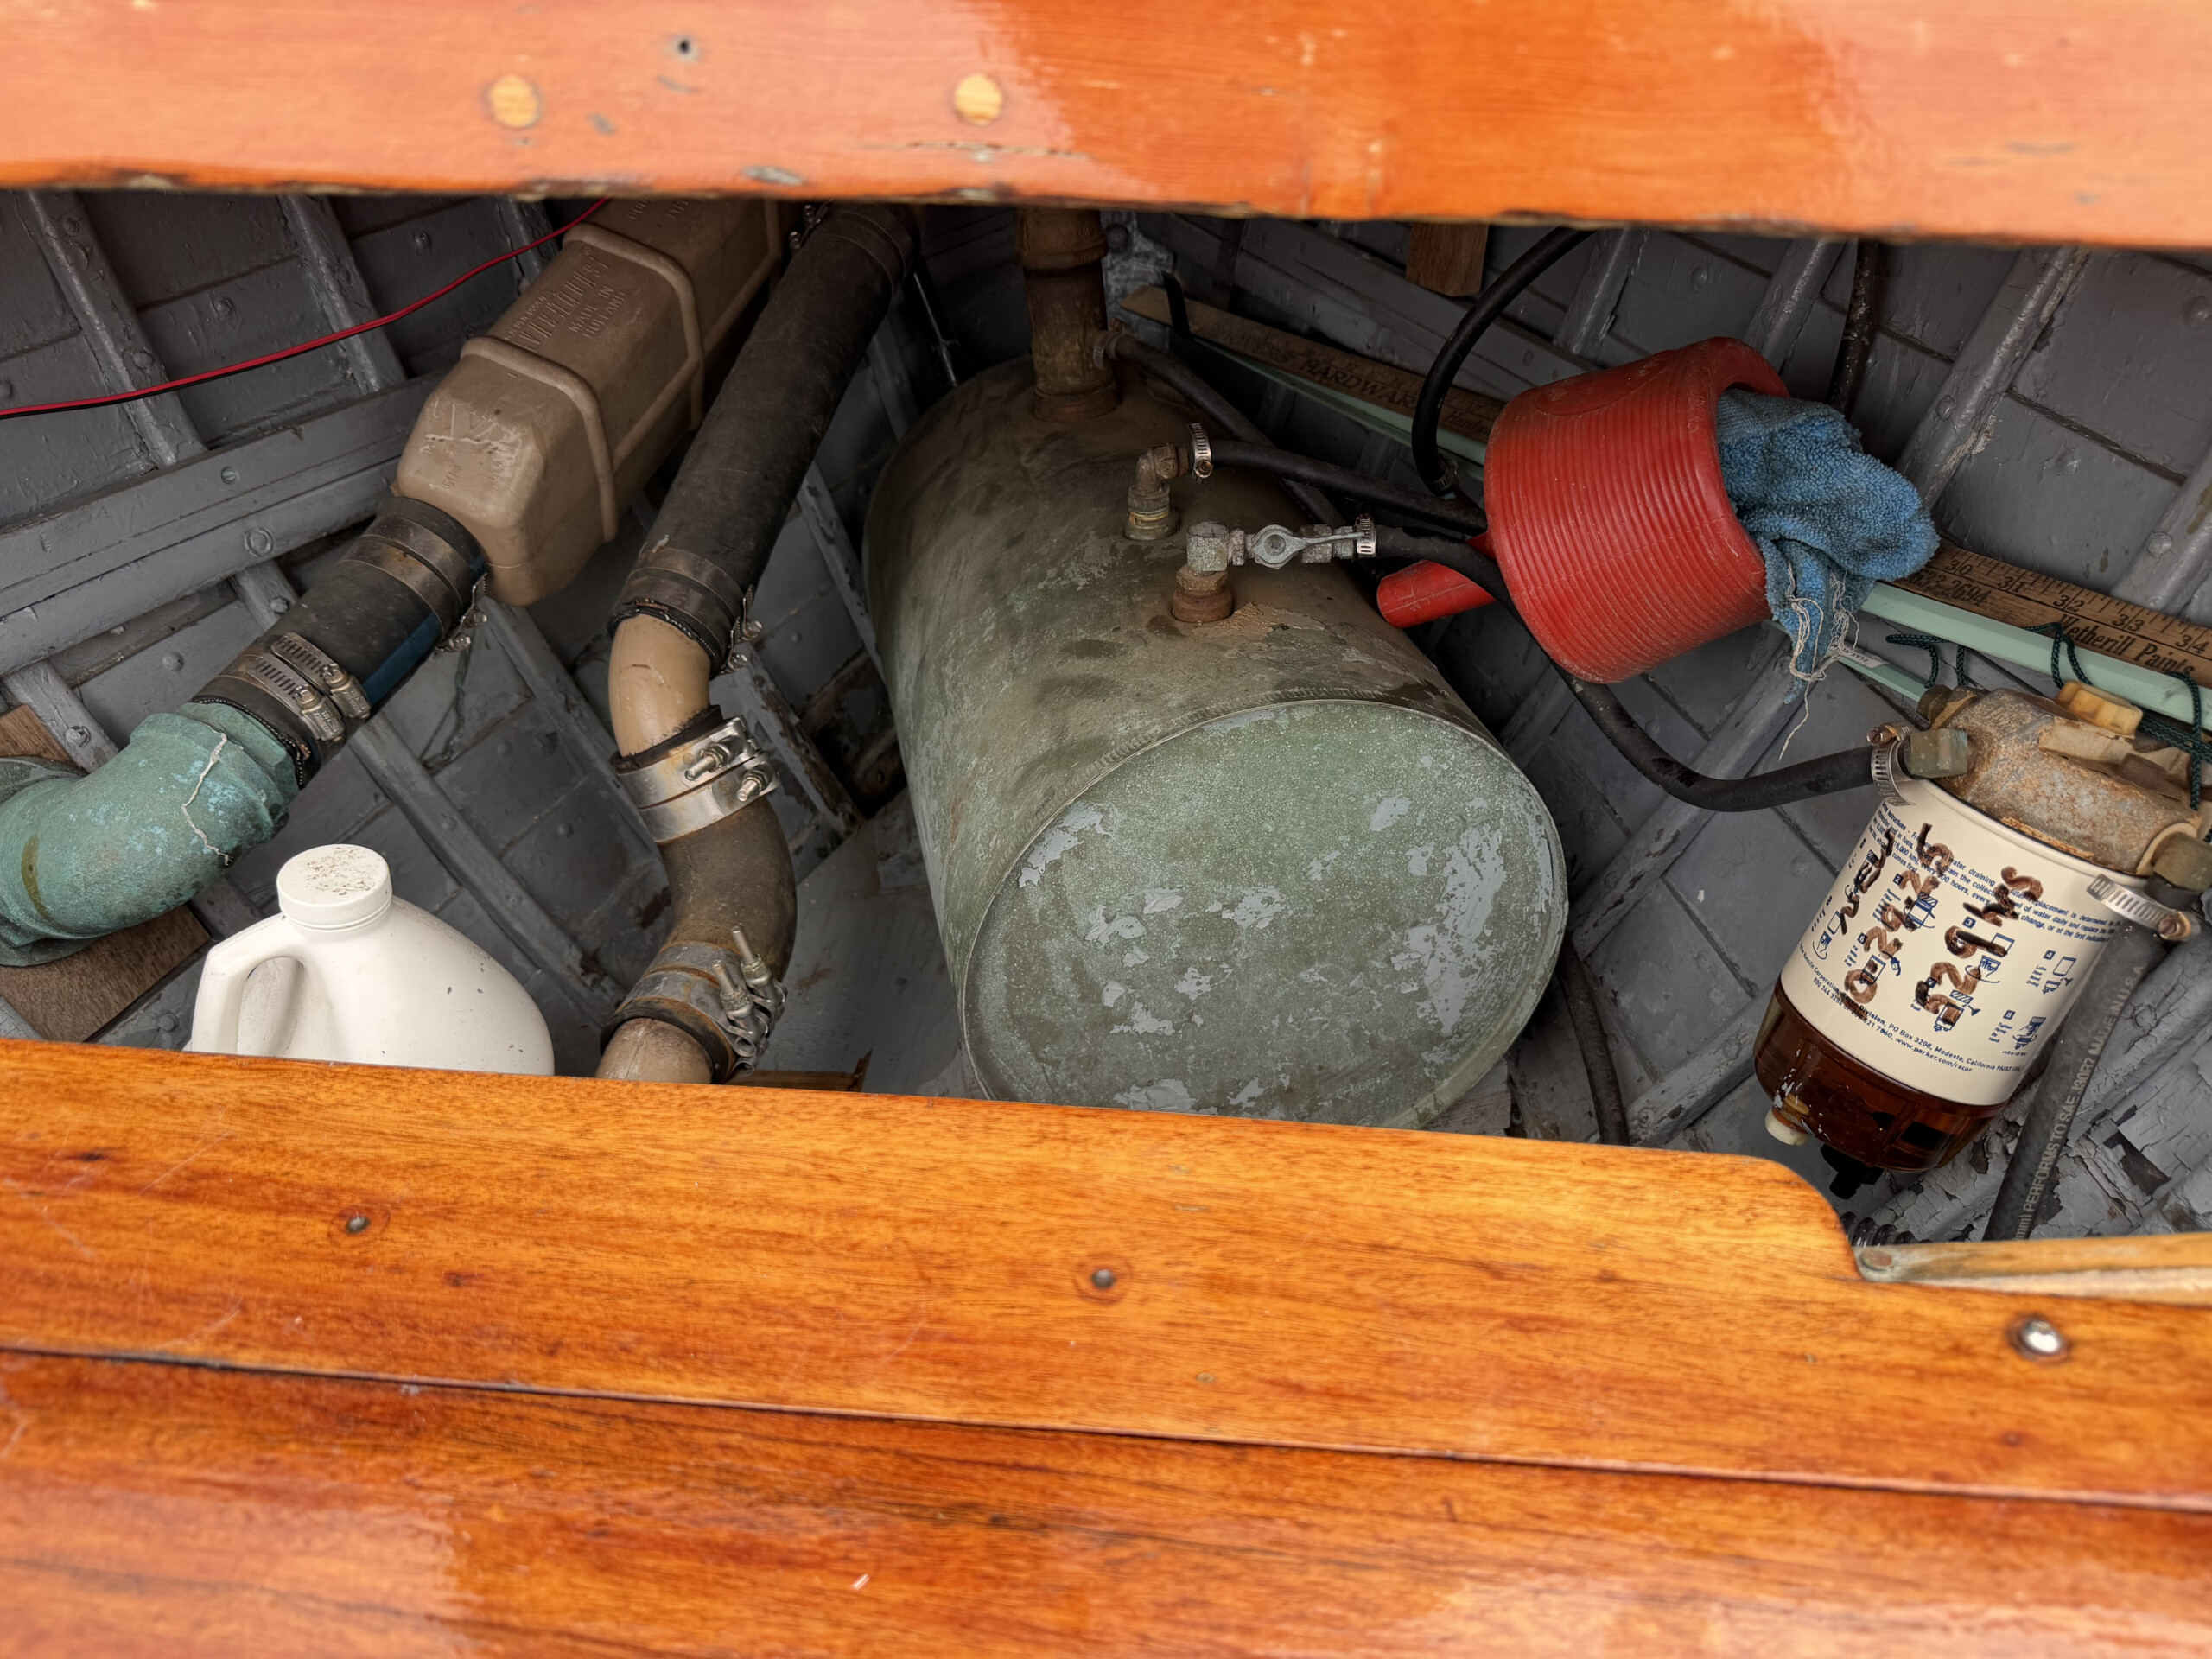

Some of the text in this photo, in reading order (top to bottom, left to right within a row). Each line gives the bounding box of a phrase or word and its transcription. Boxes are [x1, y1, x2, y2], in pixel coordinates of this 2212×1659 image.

[1298, 358, 1419, 411] HARDWAR
[2055, 613, 2136, 658] Wetherill
[1891, 852, 1908, 866] comes
[1967, 868, 1996, 887] draining
[1949, 879, 1971, 896] hours,
[1971, 892, 1991, 905] every
[2020, 913, 2046, 930] change,
[1959, 873, 1972, 884] the
[2023, 904, 2031, 912] of
[2031, 908, 2051, 919] water
[2051, 916, 2068, 926] daily
[1802, 950, 1815, 969] Hannifin
[1813, 966, 1841, 995] Corporation,
[1858, 1004, 1887, 1027] Division,
[1887, 1022, 1899, 1033] PO
[1899, 1028, 1914, 1040] Box
[1913, 1036, 1934, 1050] 3208,
[1934, 1046, 1965, 1063] Modesto,
[1966, 1057, 1995, 1070] California
[1820, 984, 1831, 995] 344
[1894, 1036, 1972, 1072] www.parker.com/racor
[2087, 1014, 2116, 1057] MADE
[2050, 1121, 2067, 1144] TO
[2058, 1094, 2077, 1123] SAE
[2021, 1139, 2060, 1214] PERFORMS
